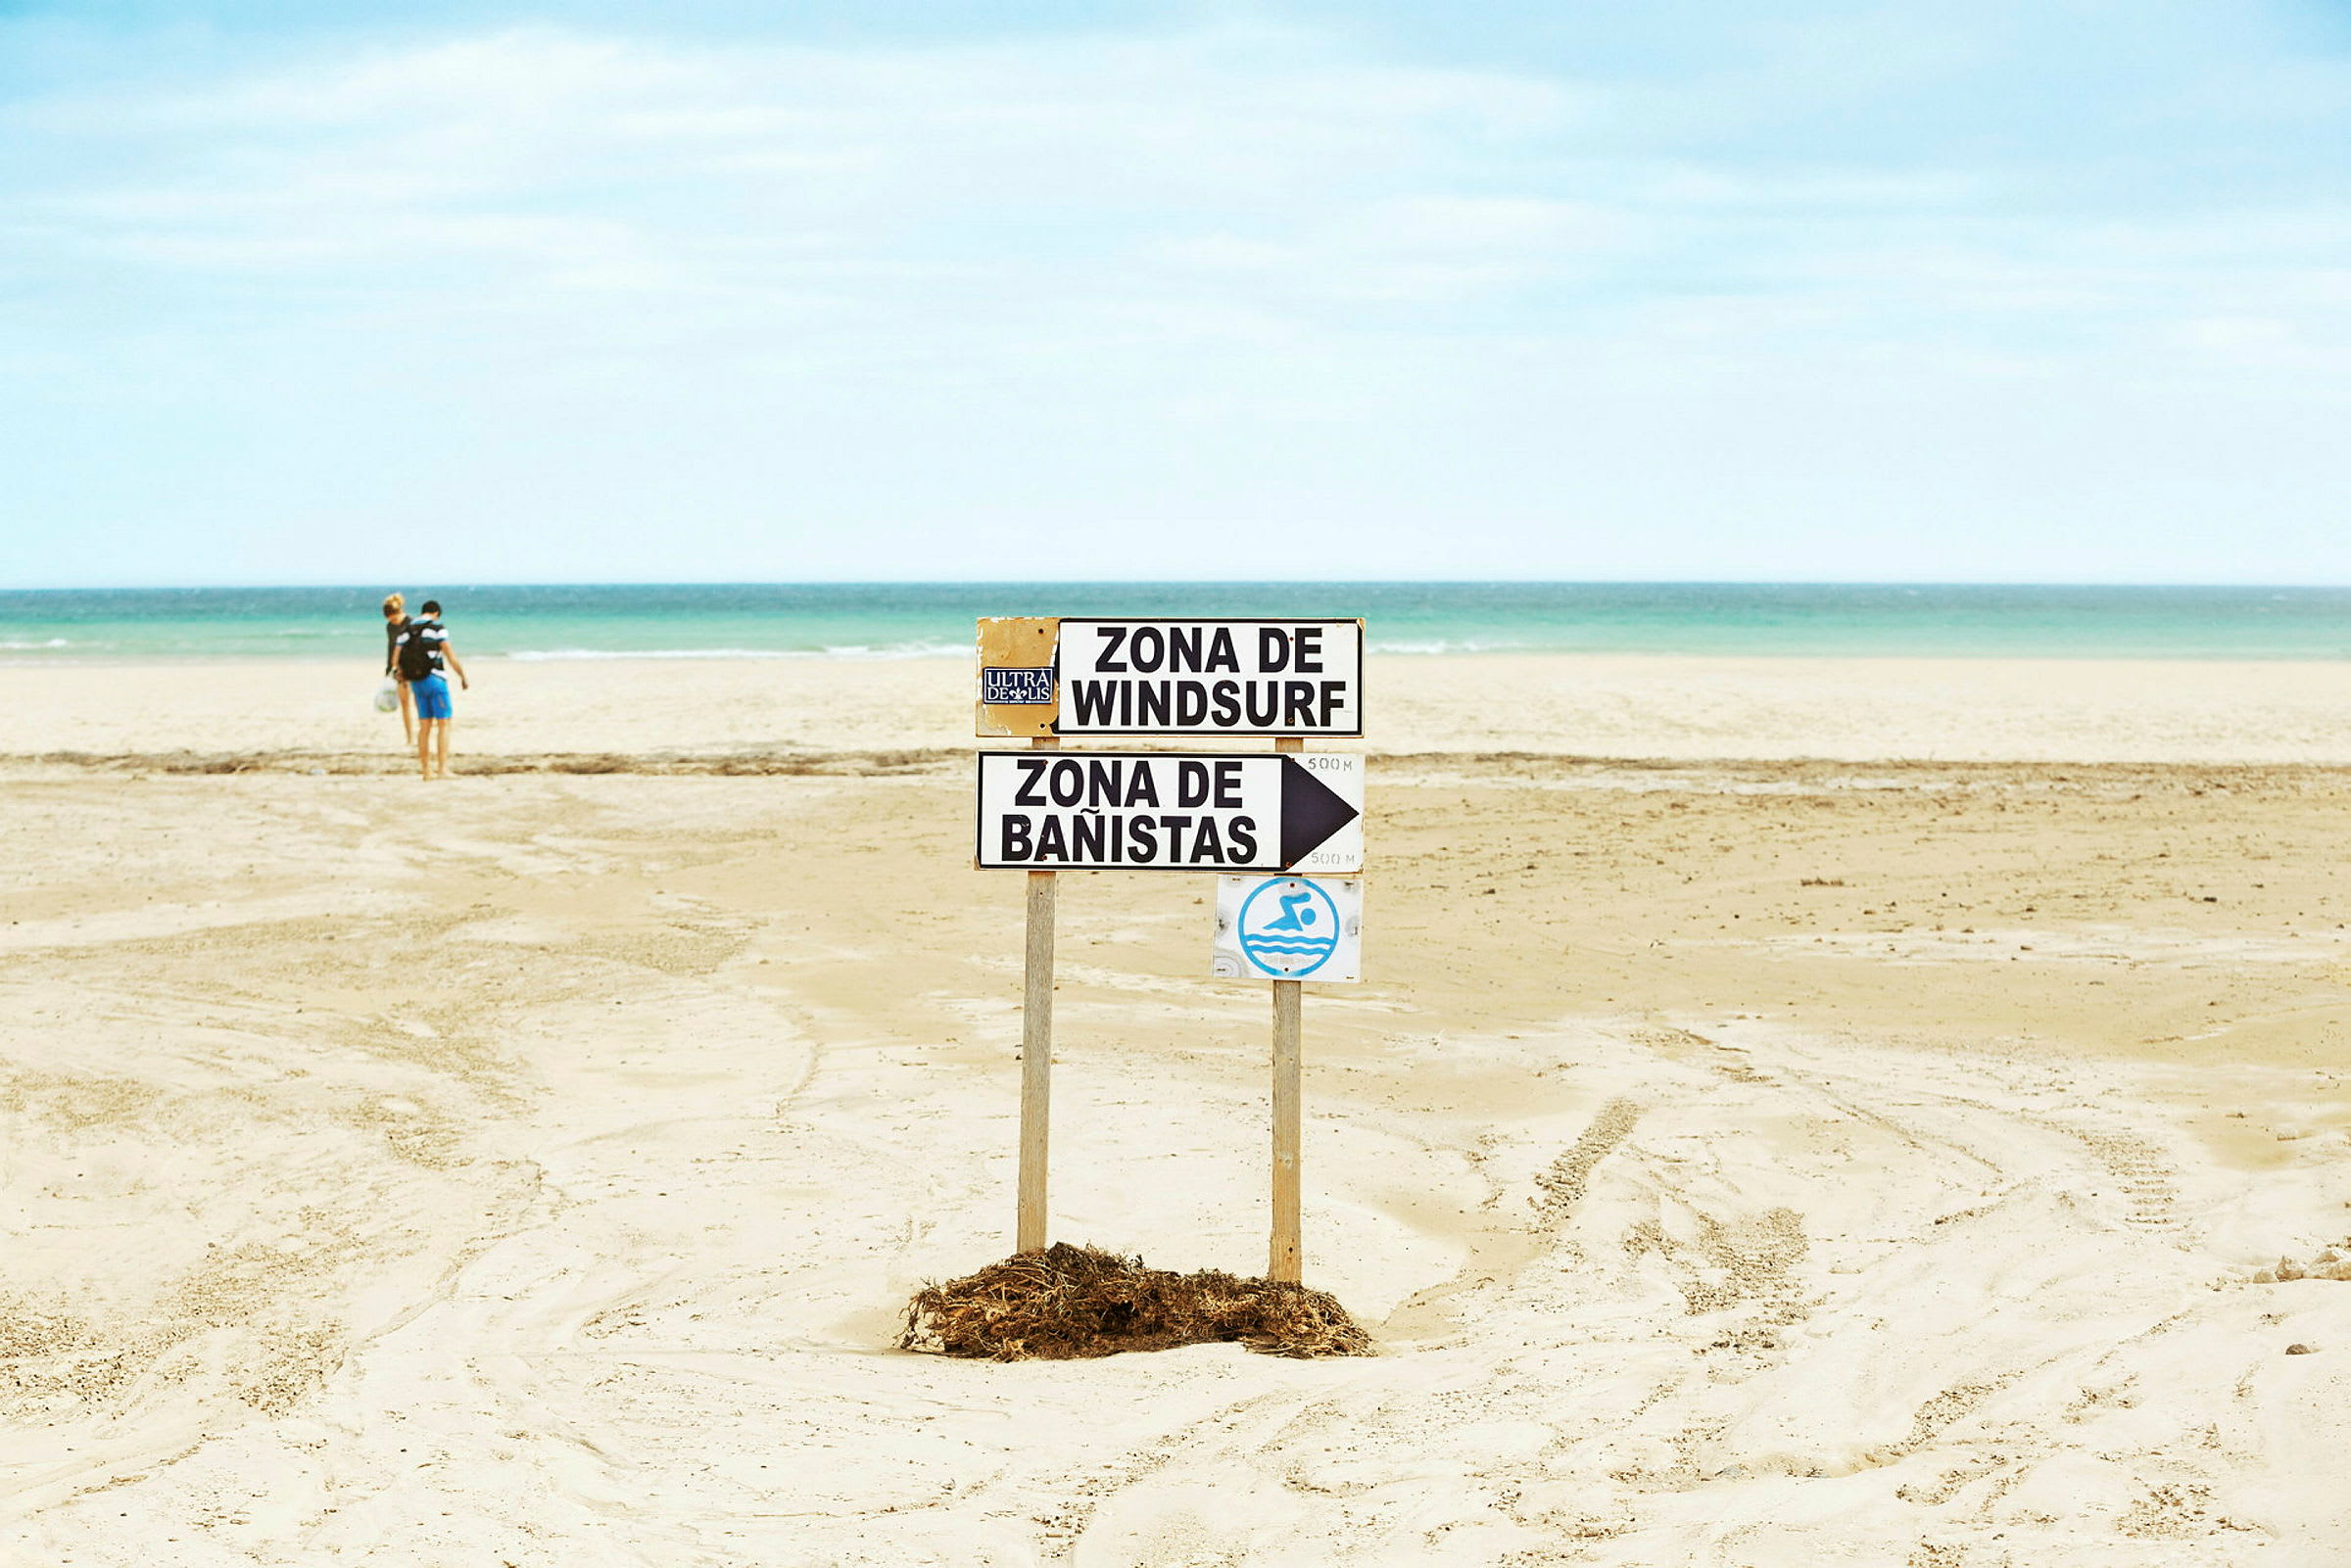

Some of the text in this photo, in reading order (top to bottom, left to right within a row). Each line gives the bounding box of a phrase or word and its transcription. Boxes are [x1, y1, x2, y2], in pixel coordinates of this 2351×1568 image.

[1095, 626, 1323, 674] ZONA DE
[987, 671, 1050, 688] ULTRA
[987, 687, 1050, 700] DE LIS
[1071, 679, 1347, 728] WINDSURF
[1015, 758, 1244, 809] ZONA DE
[1001, 806, 1259, 864] BAÑISTAS
